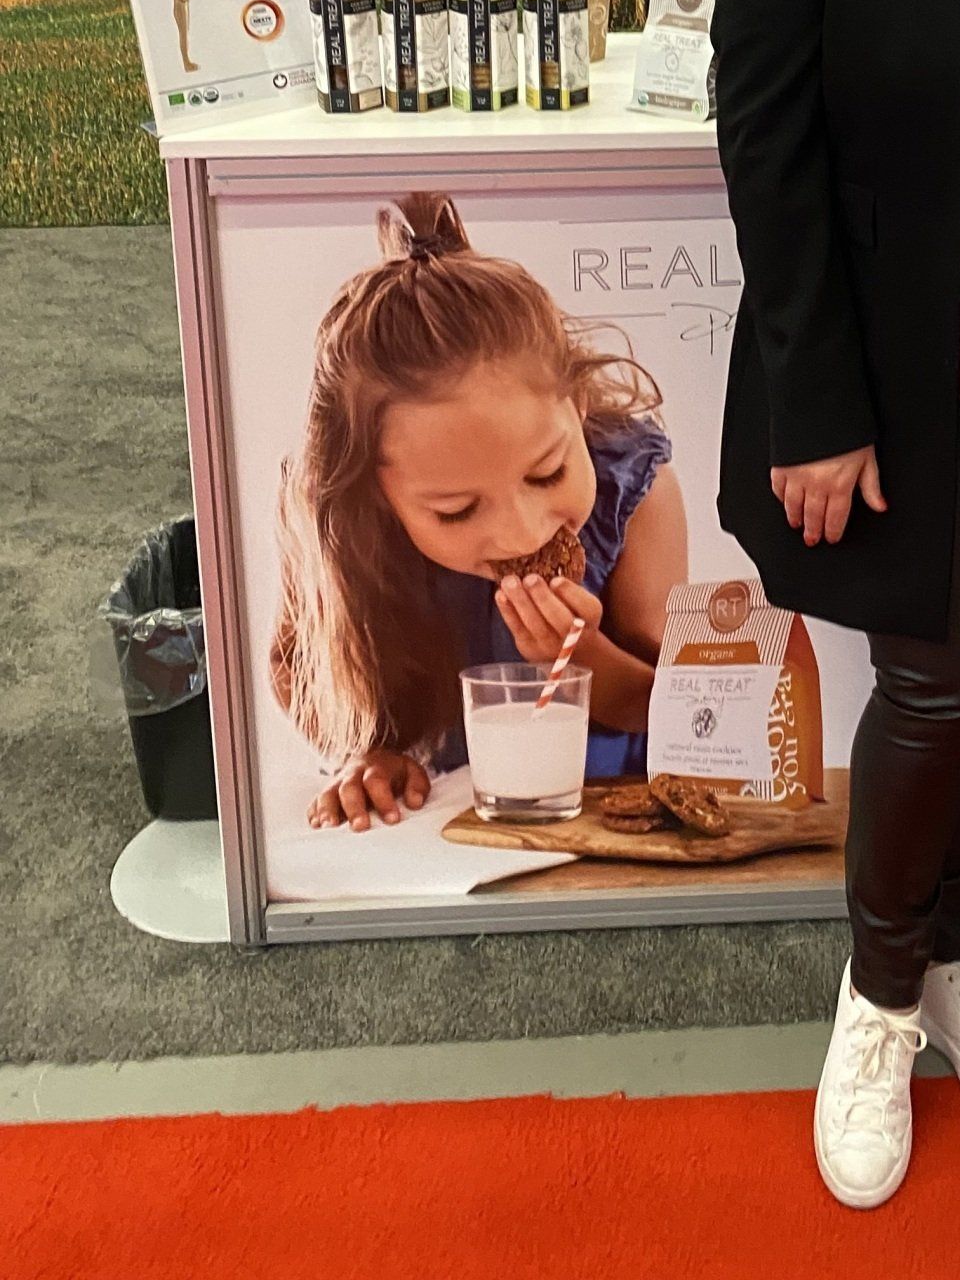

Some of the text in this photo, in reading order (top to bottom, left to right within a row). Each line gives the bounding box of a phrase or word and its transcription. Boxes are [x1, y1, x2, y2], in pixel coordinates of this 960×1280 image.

[331, 32, 343, 66] REAL
[401, 32, 412, 66] REAL
[475, 31, 486, 65] REAL
[573, 244, 741, 292] REAL
[715, 598, 742, 617] RT
[669, 677, 701, 692] REAL
